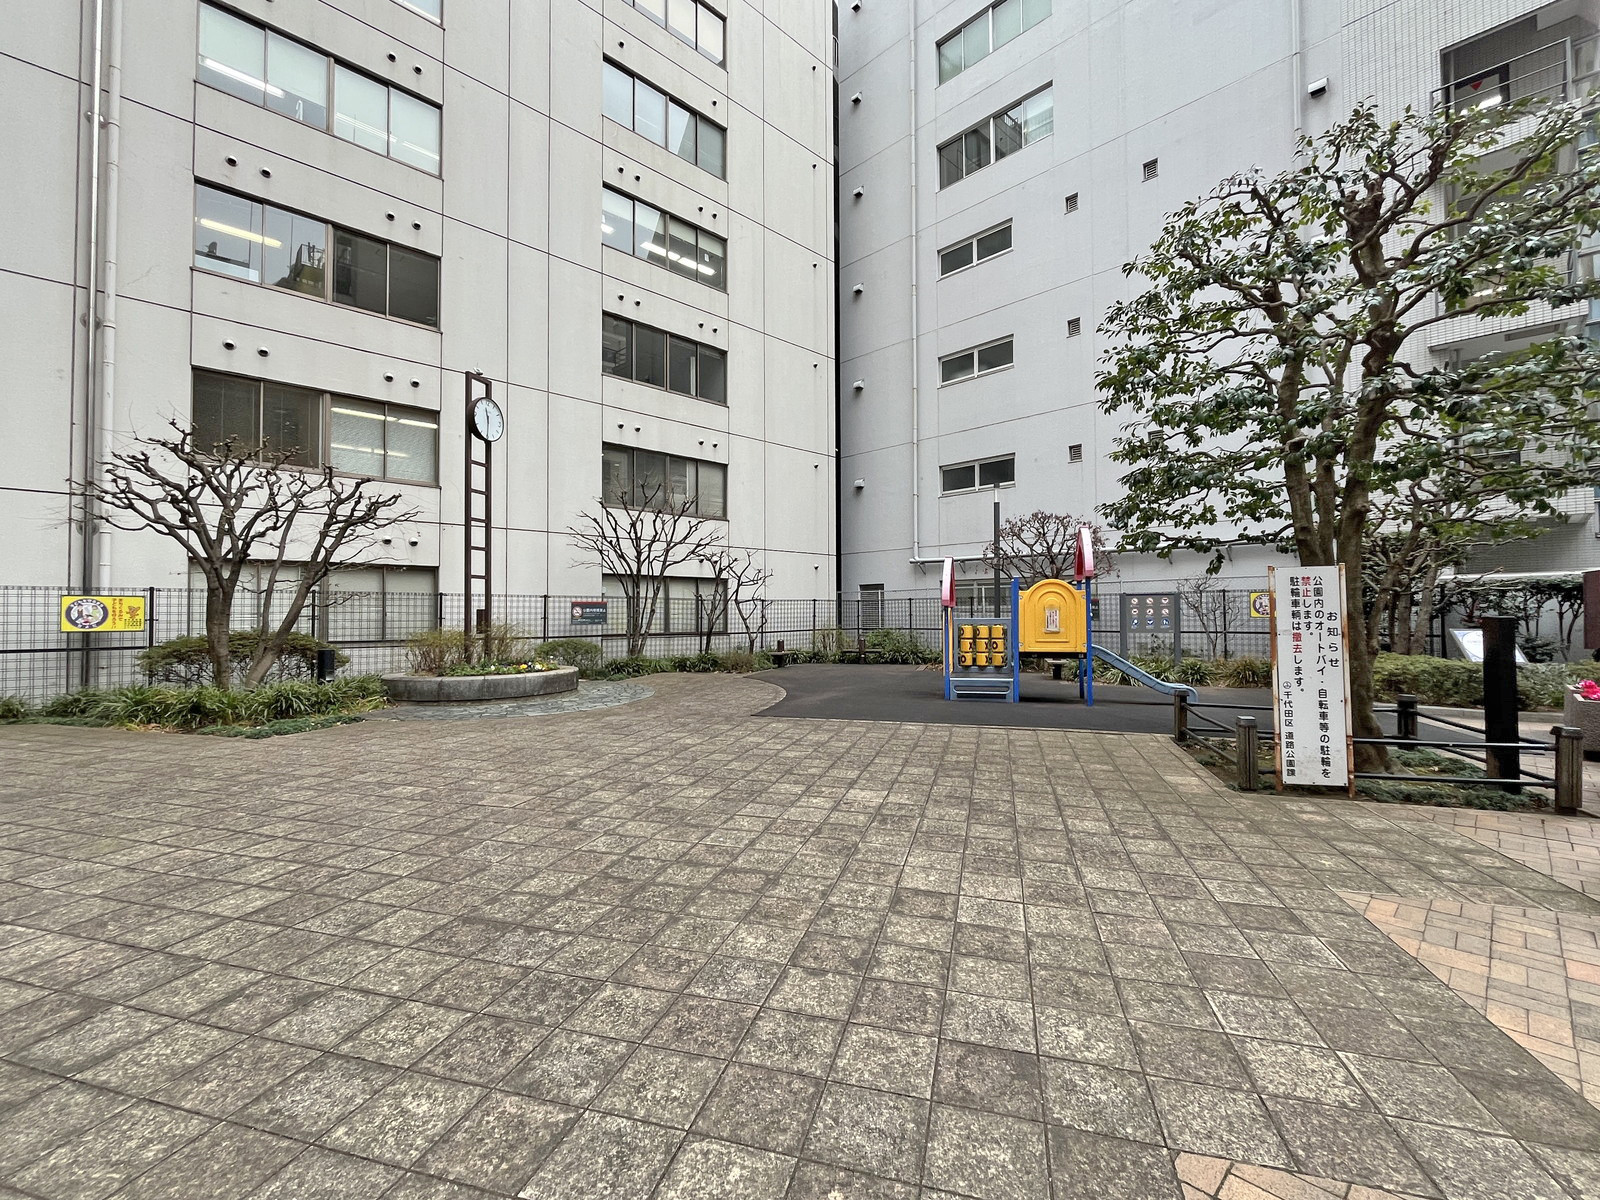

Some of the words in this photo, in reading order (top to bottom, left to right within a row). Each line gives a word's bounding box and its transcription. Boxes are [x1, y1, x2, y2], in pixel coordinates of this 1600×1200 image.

[1301, 576, 1314, 636] 禁止します。
[1326, 611, 1340, 668] お知らせ
[1312, 575, 1331, 779] 公園内のオートバイ・自転車等の駐輪を
